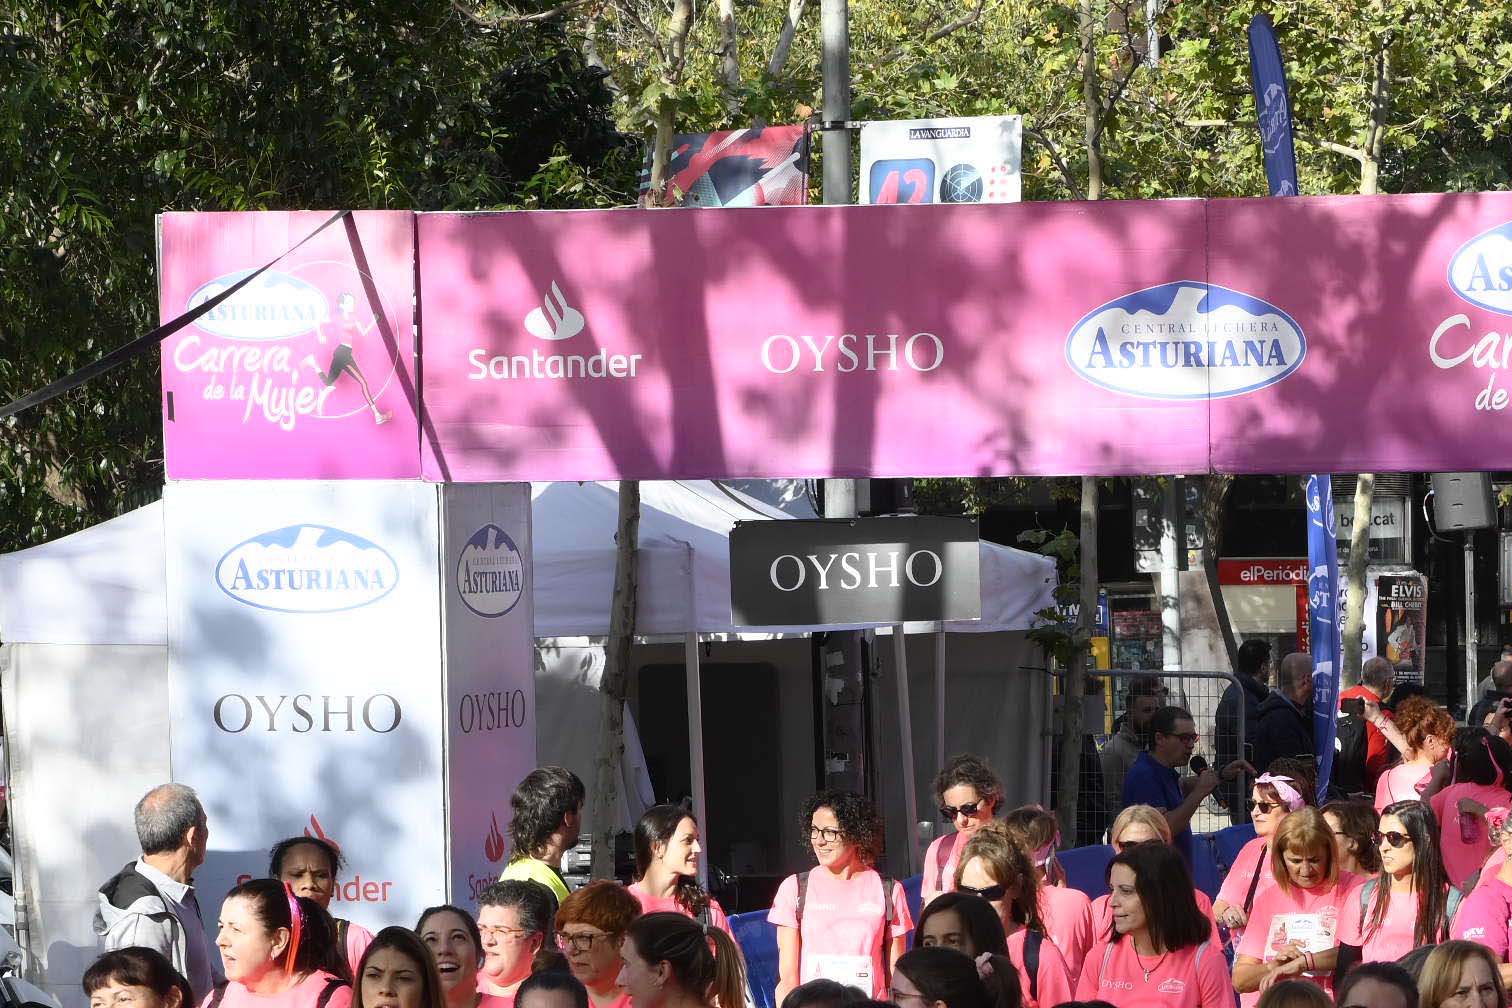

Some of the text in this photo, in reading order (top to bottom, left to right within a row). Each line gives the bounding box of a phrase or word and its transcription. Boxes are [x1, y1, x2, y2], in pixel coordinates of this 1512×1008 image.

[1085, 326, 1288, 369] ASTURIANA
[1121, 323, 1196, 334] CENTRAL
[173, 335, 292, 372] Carrera
[468, 348, 641, 380] Santander
[760, 332, 944, 374] OYSHO
[203, 369, 336, 431] de la Mujer
[1475, 372, 1508, 411] de
[230, 557, 386, 590] ASTURIANA
[463, 560, 520, 594] ASTURIANA
[770, 550, 943, 592] OYSHO
[1240, 564, 1310, 582] elPeriódi
[1391, 585, 1422, 597] ELVIS
[213, 693, 403, 734] OYSHO
[460, 688, 527, 734] OYSHO
